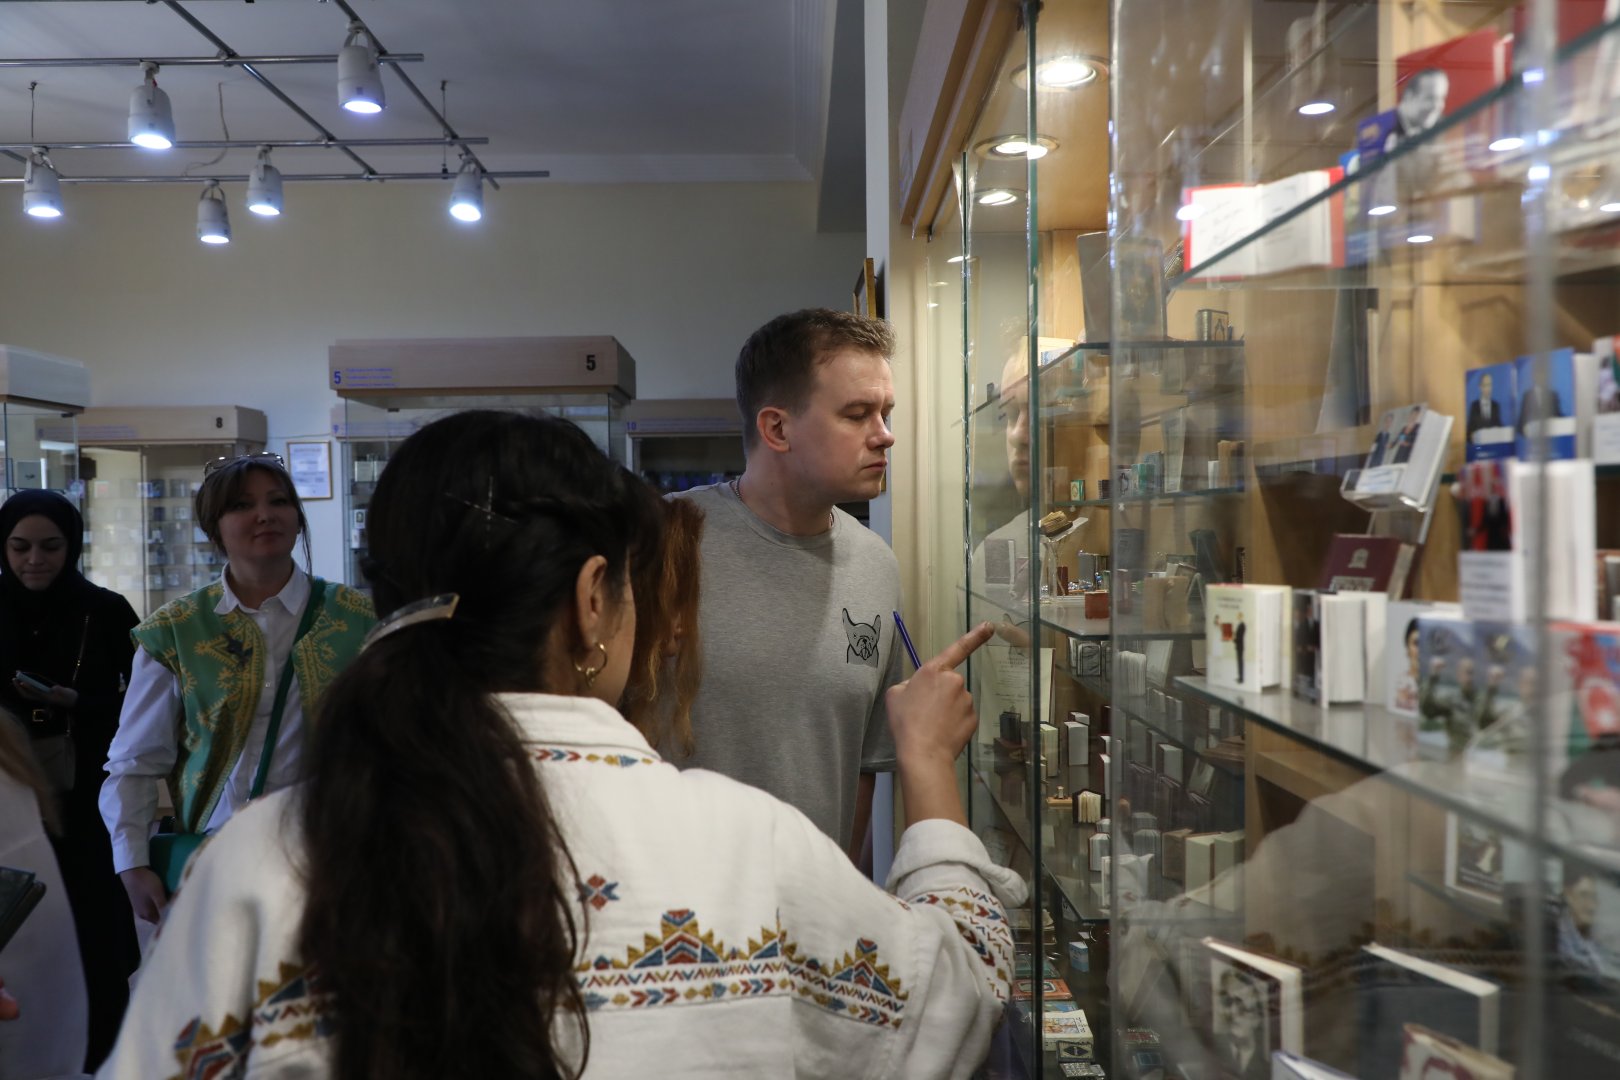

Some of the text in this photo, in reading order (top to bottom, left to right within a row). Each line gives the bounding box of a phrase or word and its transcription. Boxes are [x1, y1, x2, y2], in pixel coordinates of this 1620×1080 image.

[586, 354, 596, 371] 5
[333, 370, 341, 384] 5
[215, 416, 223, 428] 8
